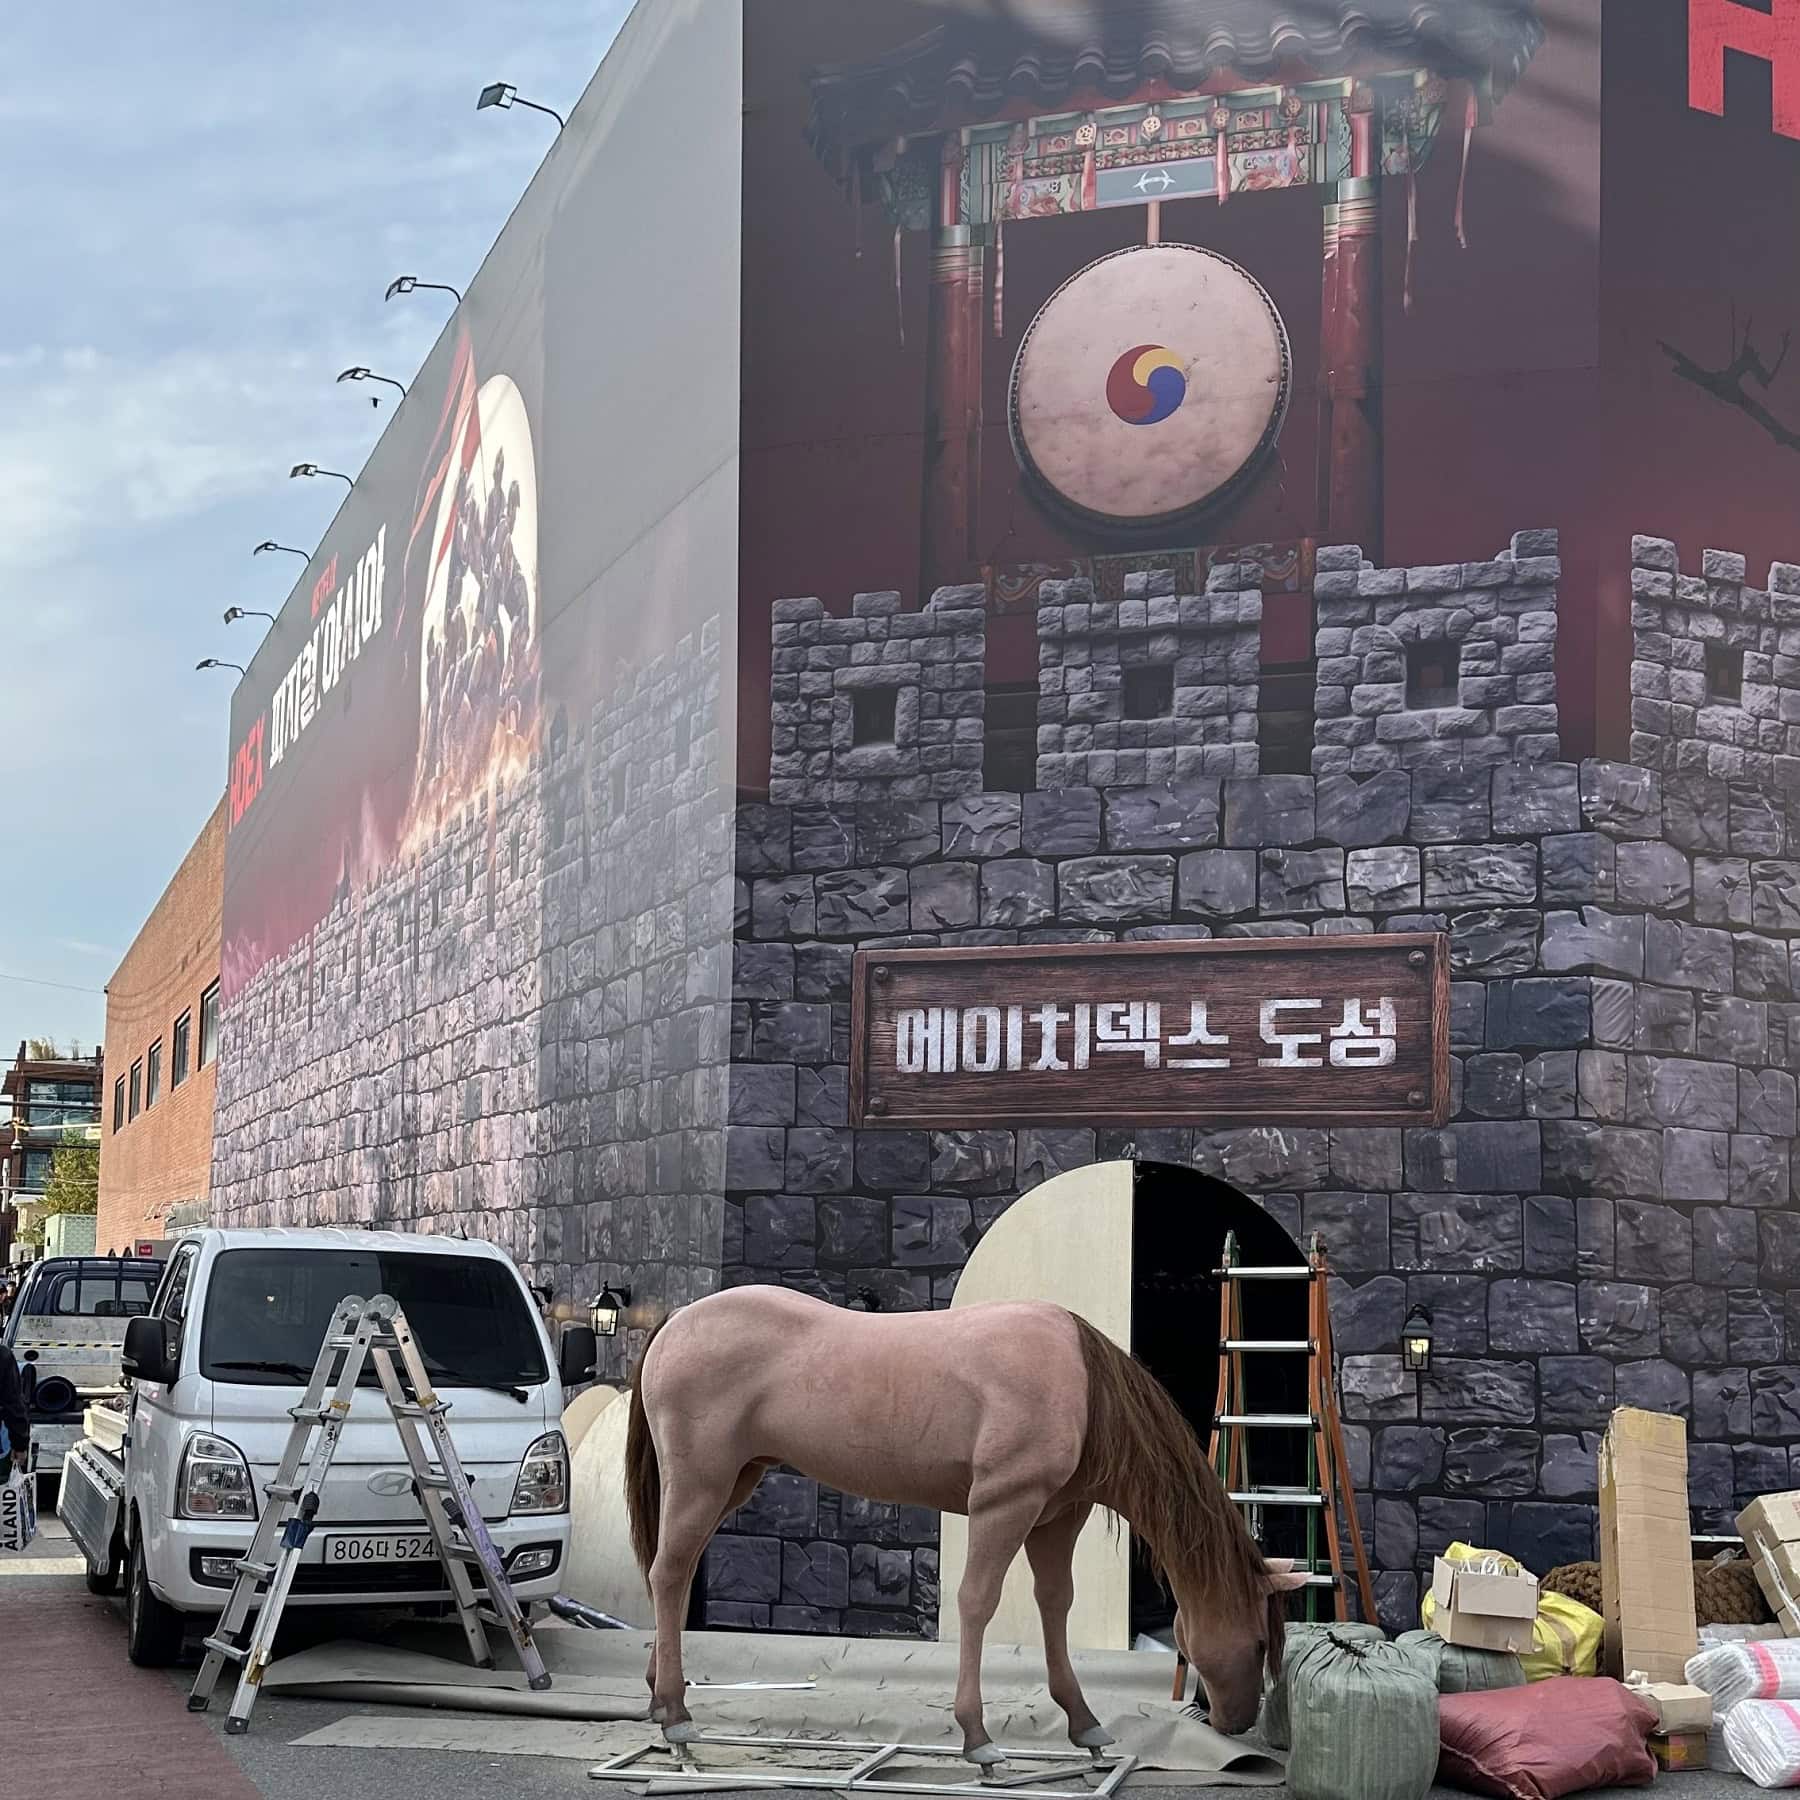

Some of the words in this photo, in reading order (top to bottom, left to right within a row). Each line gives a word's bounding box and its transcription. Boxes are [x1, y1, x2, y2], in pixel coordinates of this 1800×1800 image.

[322, 523, 386, 694] 아시아
[896, 1000, 1231, 1073] 에이치덱스
[1257, 997, 1398, 1068] 도성
[334, 1540, 389, 1560] 806다
[395, 1538, 439, 1558] 524
